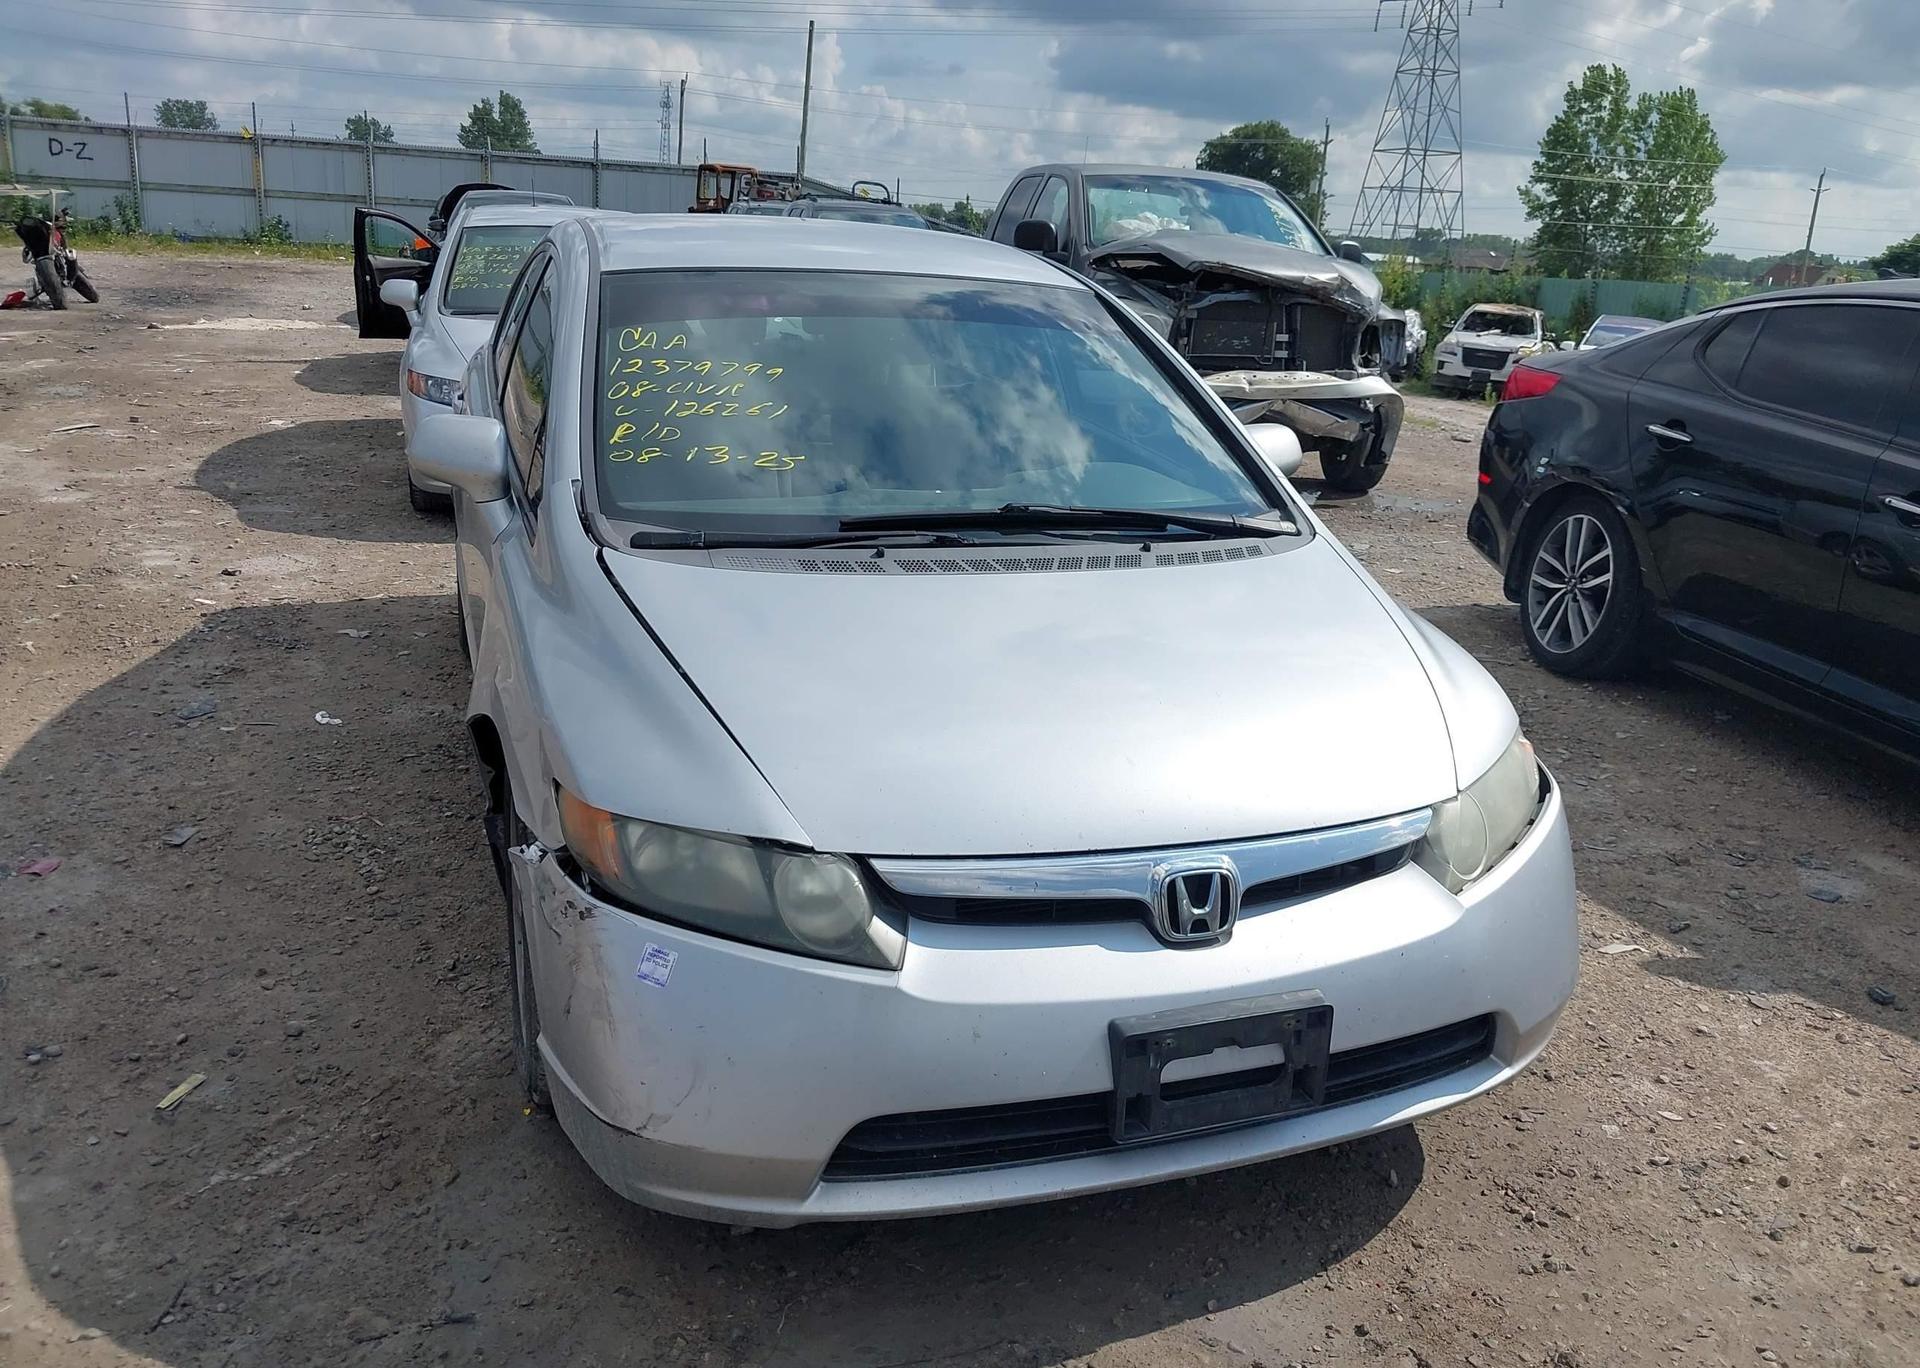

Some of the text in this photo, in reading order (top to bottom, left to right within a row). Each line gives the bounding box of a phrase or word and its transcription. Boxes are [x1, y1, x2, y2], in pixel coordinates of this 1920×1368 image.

[618, 327, 688, 352] CAA
[609, 357, 784, 383] 12379799
[648, 952, 670, 964] REPORTED
[652, 958, 668, 970] POLICE
